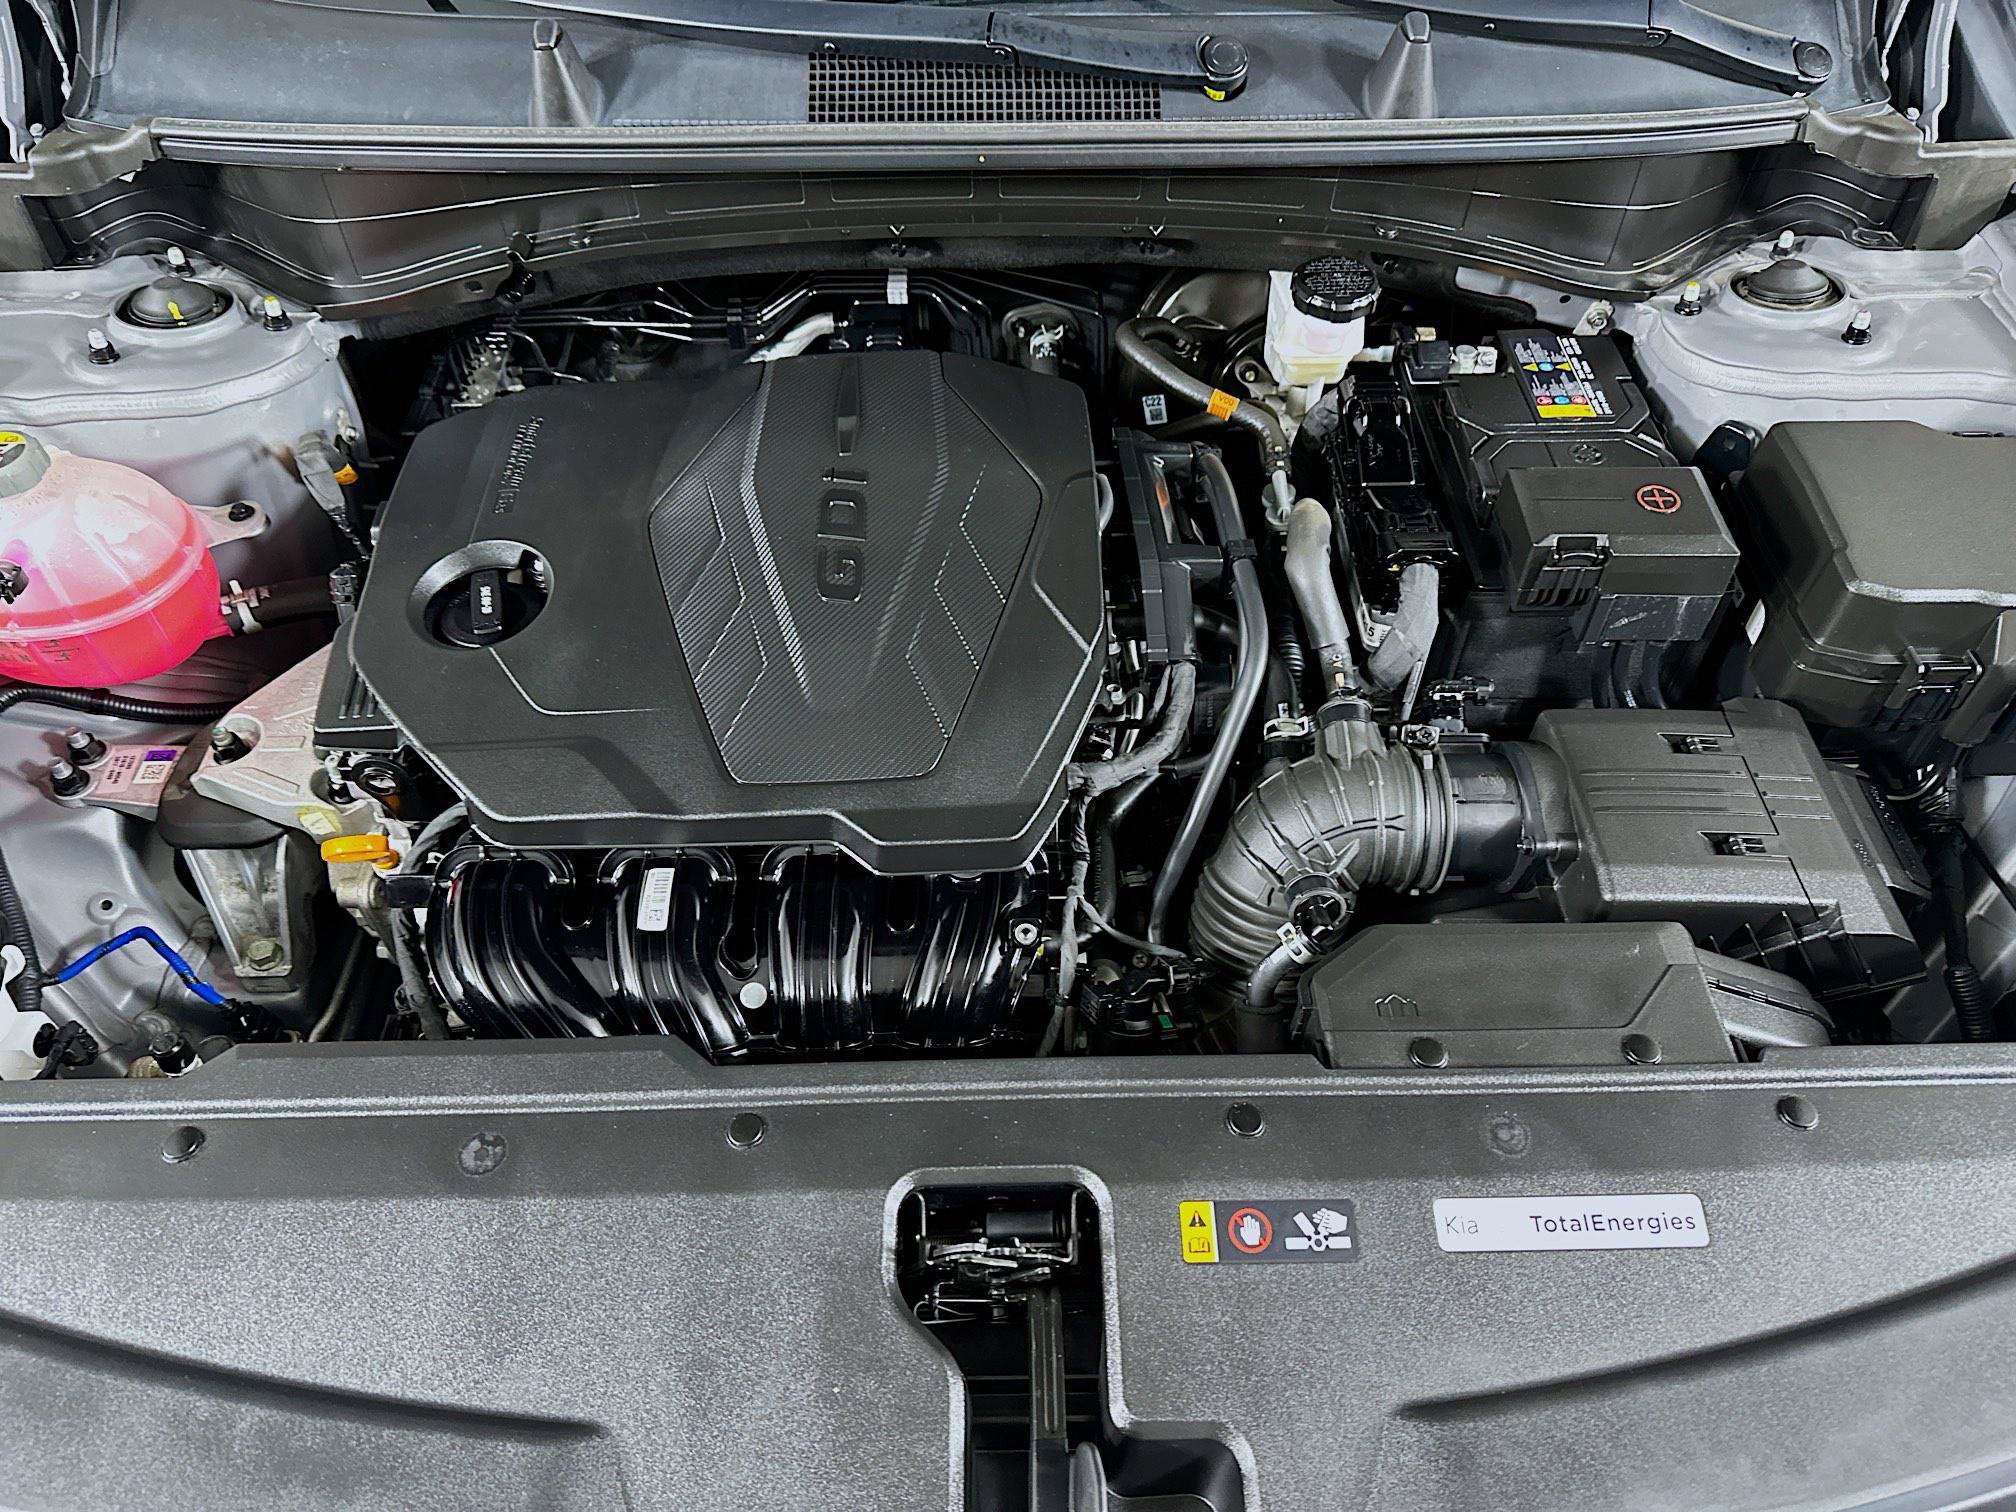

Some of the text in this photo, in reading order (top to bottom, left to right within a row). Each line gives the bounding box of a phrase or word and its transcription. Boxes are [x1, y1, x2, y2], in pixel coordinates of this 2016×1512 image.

[1145, 396, 1162, 408] C22
[1445, 1212, 1696, 1235] Kia TotalEnergies
